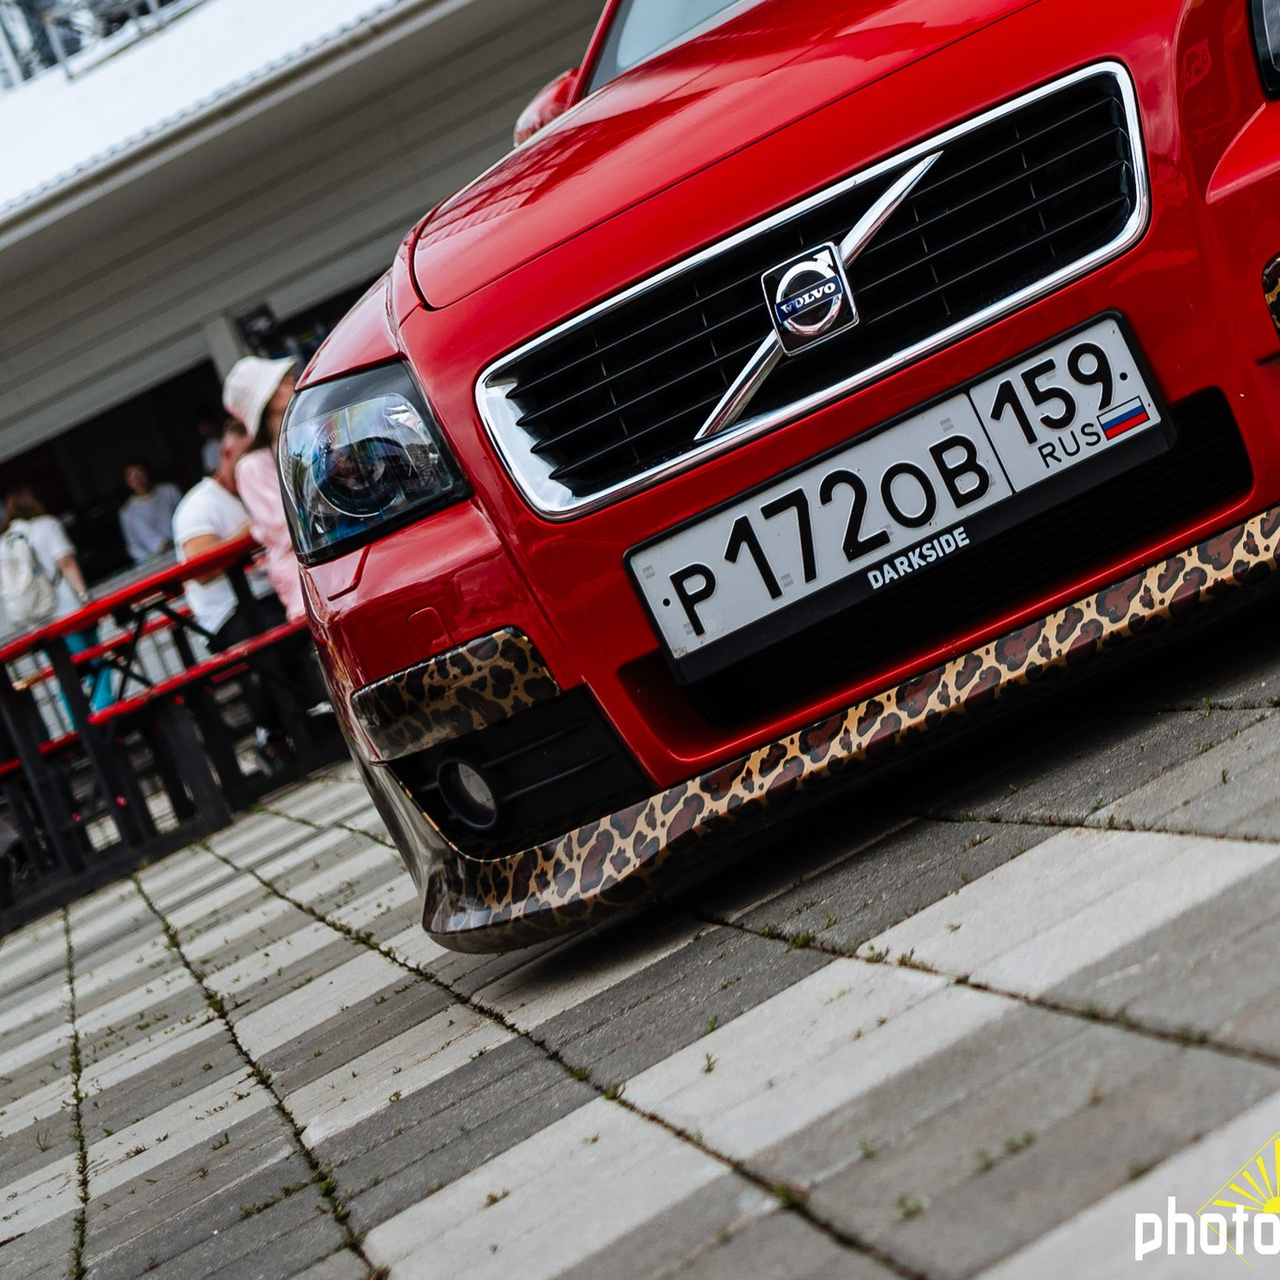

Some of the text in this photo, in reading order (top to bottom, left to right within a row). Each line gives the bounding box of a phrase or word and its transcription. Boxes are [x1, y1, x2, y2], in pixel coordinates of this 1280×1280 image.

[780, 282, 836, 314] VOLVO
[1037, 422, 1102, 468] RUS
[866, 526, 970, 590] DARKSIDE
